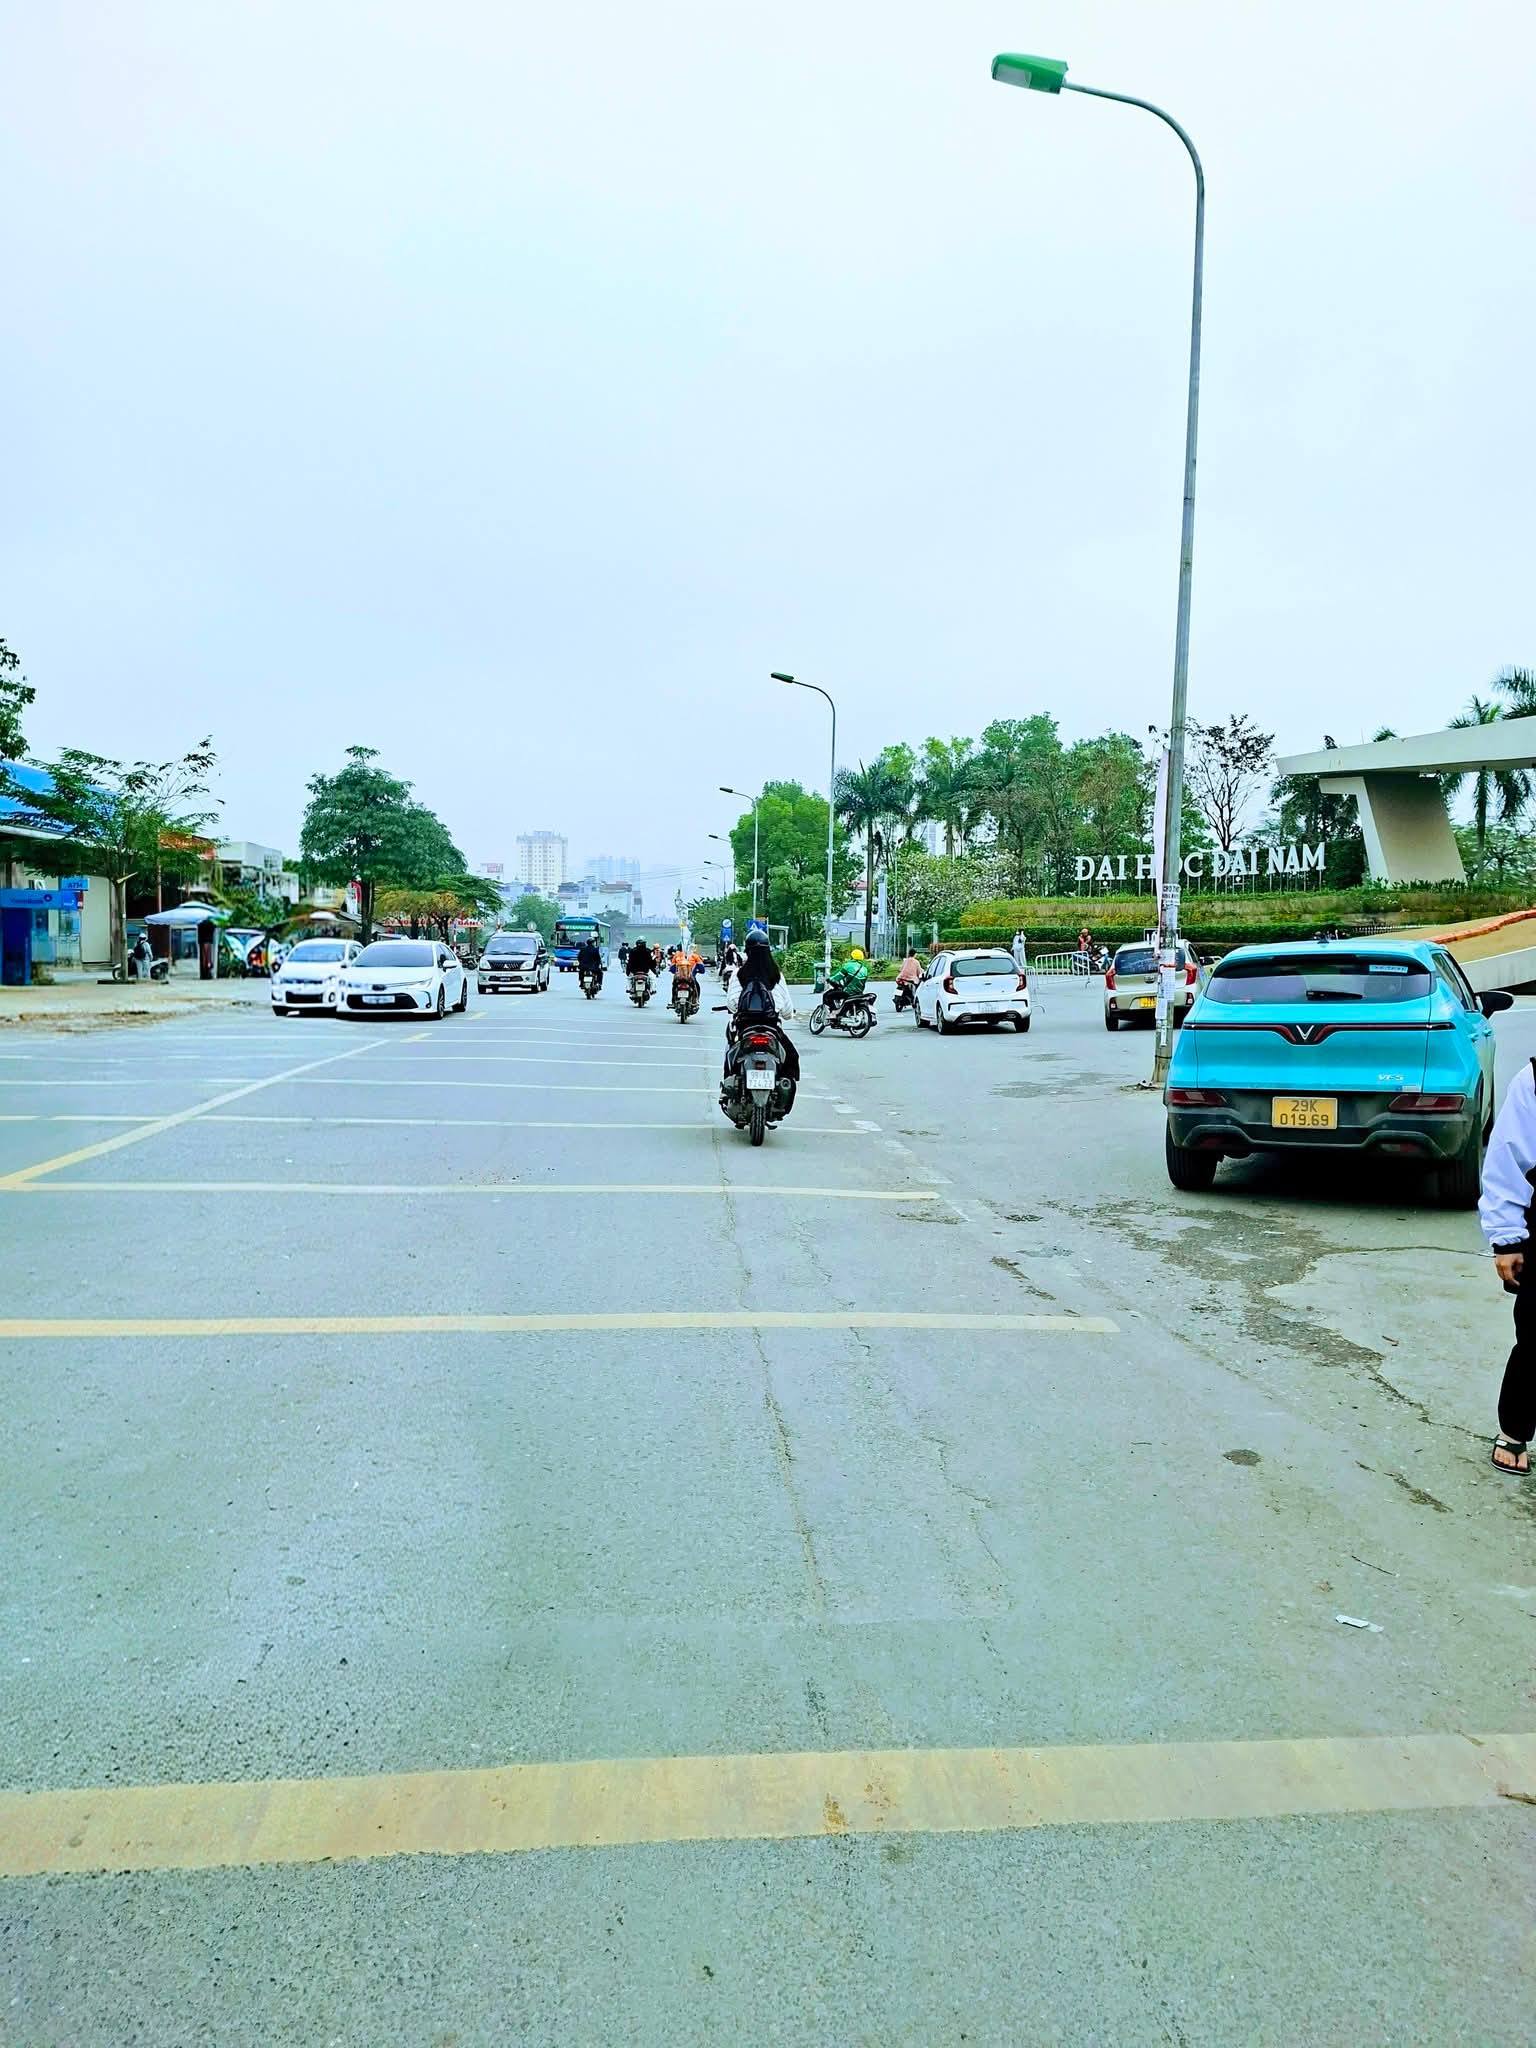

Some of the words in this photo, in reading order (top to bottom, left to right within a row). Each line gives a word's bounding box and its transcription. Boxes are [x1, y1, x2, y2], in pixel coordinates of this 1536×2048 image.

[1074, 855, 1127, 886] ĐẠI
[1134, 851, 1204, 880] HC
[1267, 842, 1326, 875] NAM
[1290, 1100, 1318, 1112] 29K
[1280, 1113, 1329, 1127] 019.69
